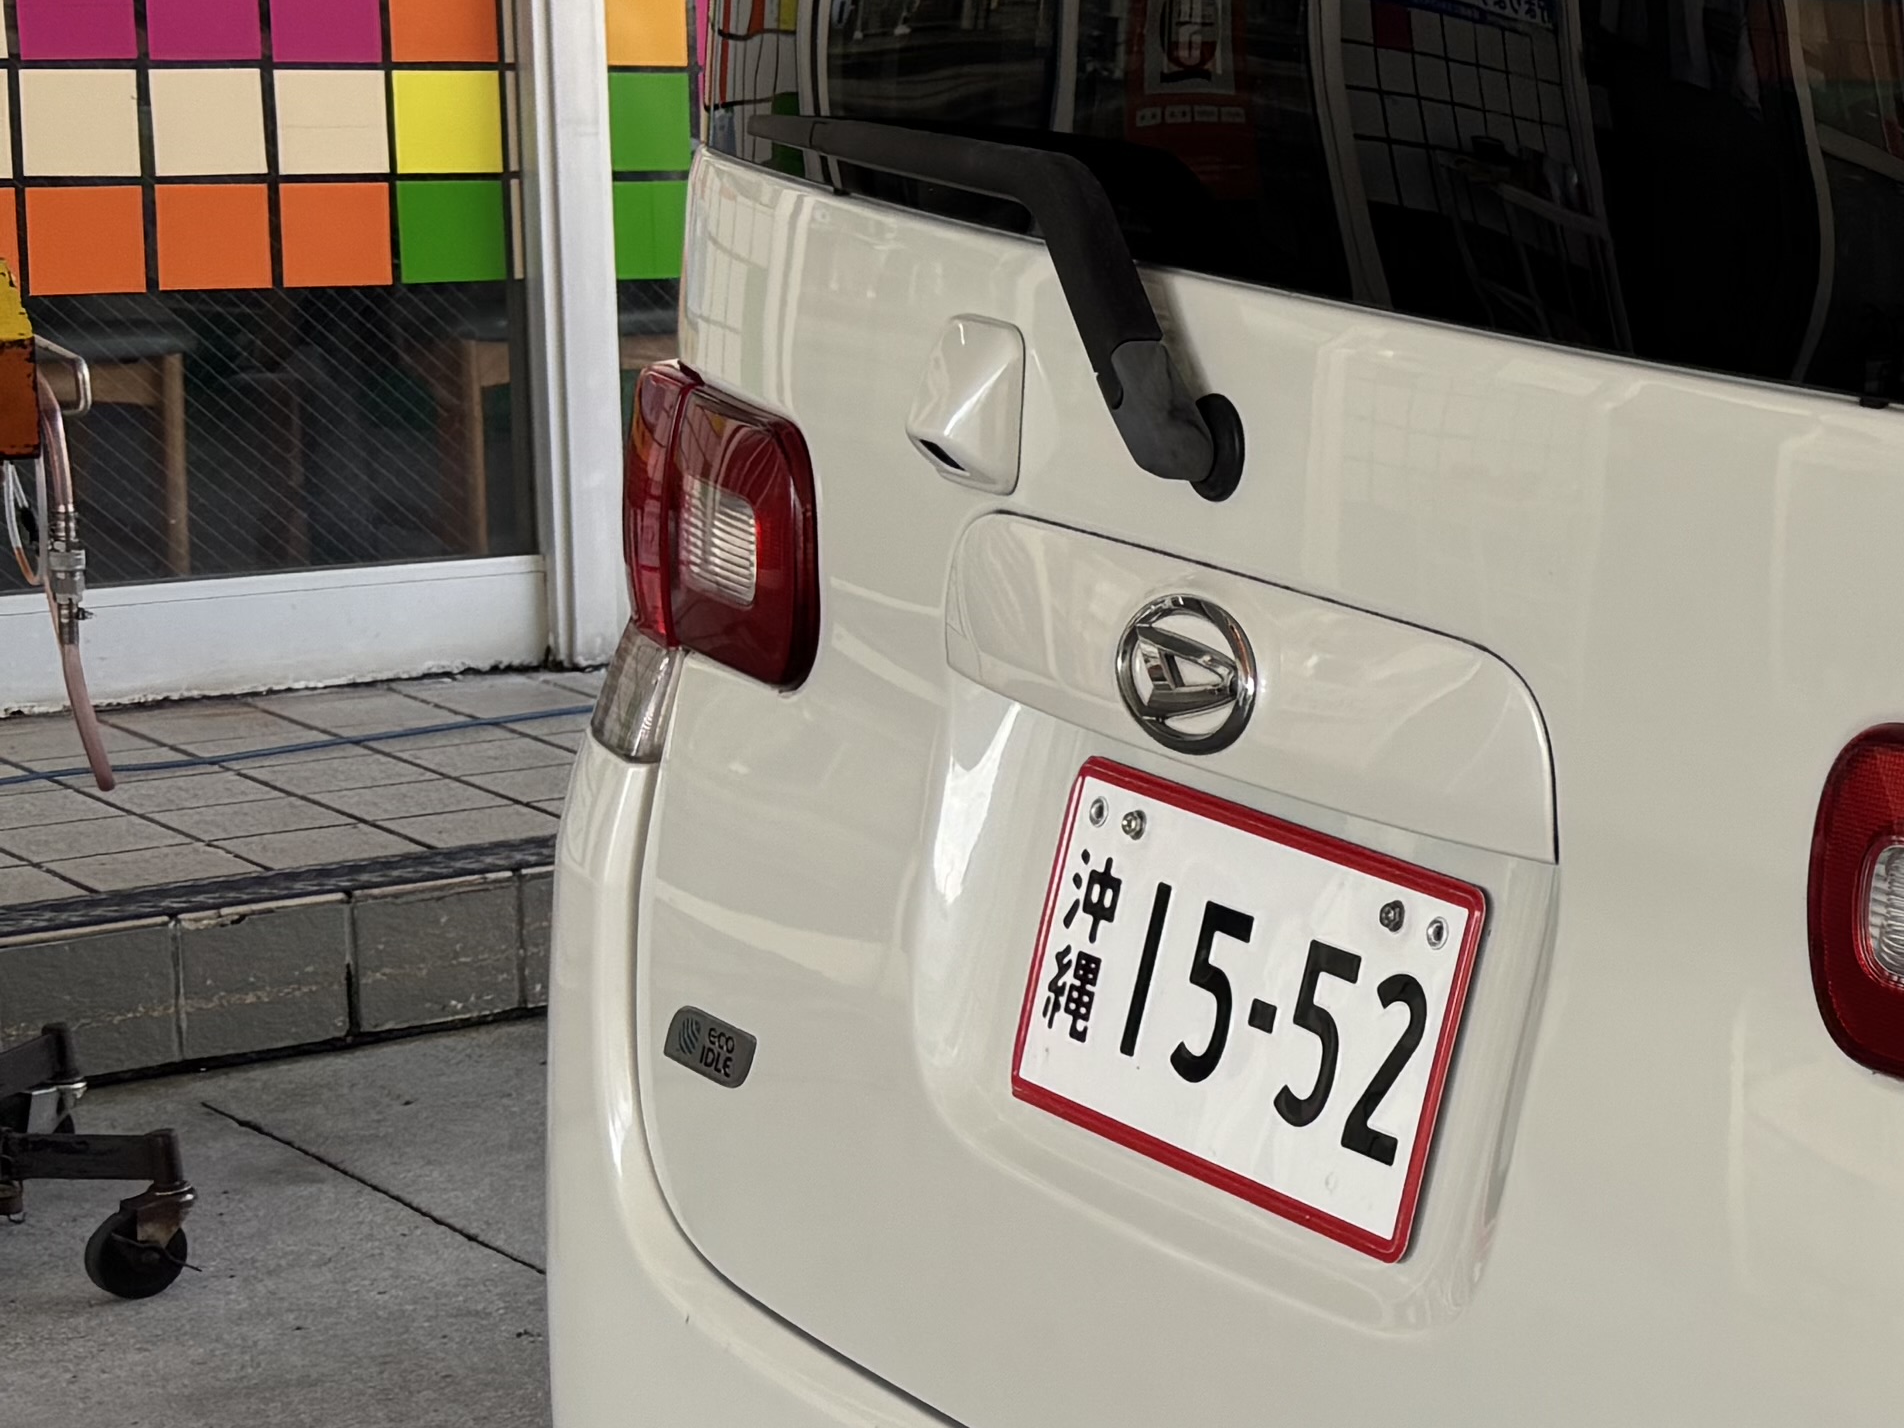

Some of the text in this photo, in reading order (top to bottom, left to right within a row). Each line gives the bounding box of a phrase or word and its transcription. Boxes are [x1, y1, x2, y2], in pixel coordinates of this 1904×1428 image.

[1044, 847, 1123, 1044] 沖縄
[699, 1045, 733, 1079] IDLE
[707, 1027, 735, 1055] ECO
[1119, 881, 1428, 1167] 15-52
